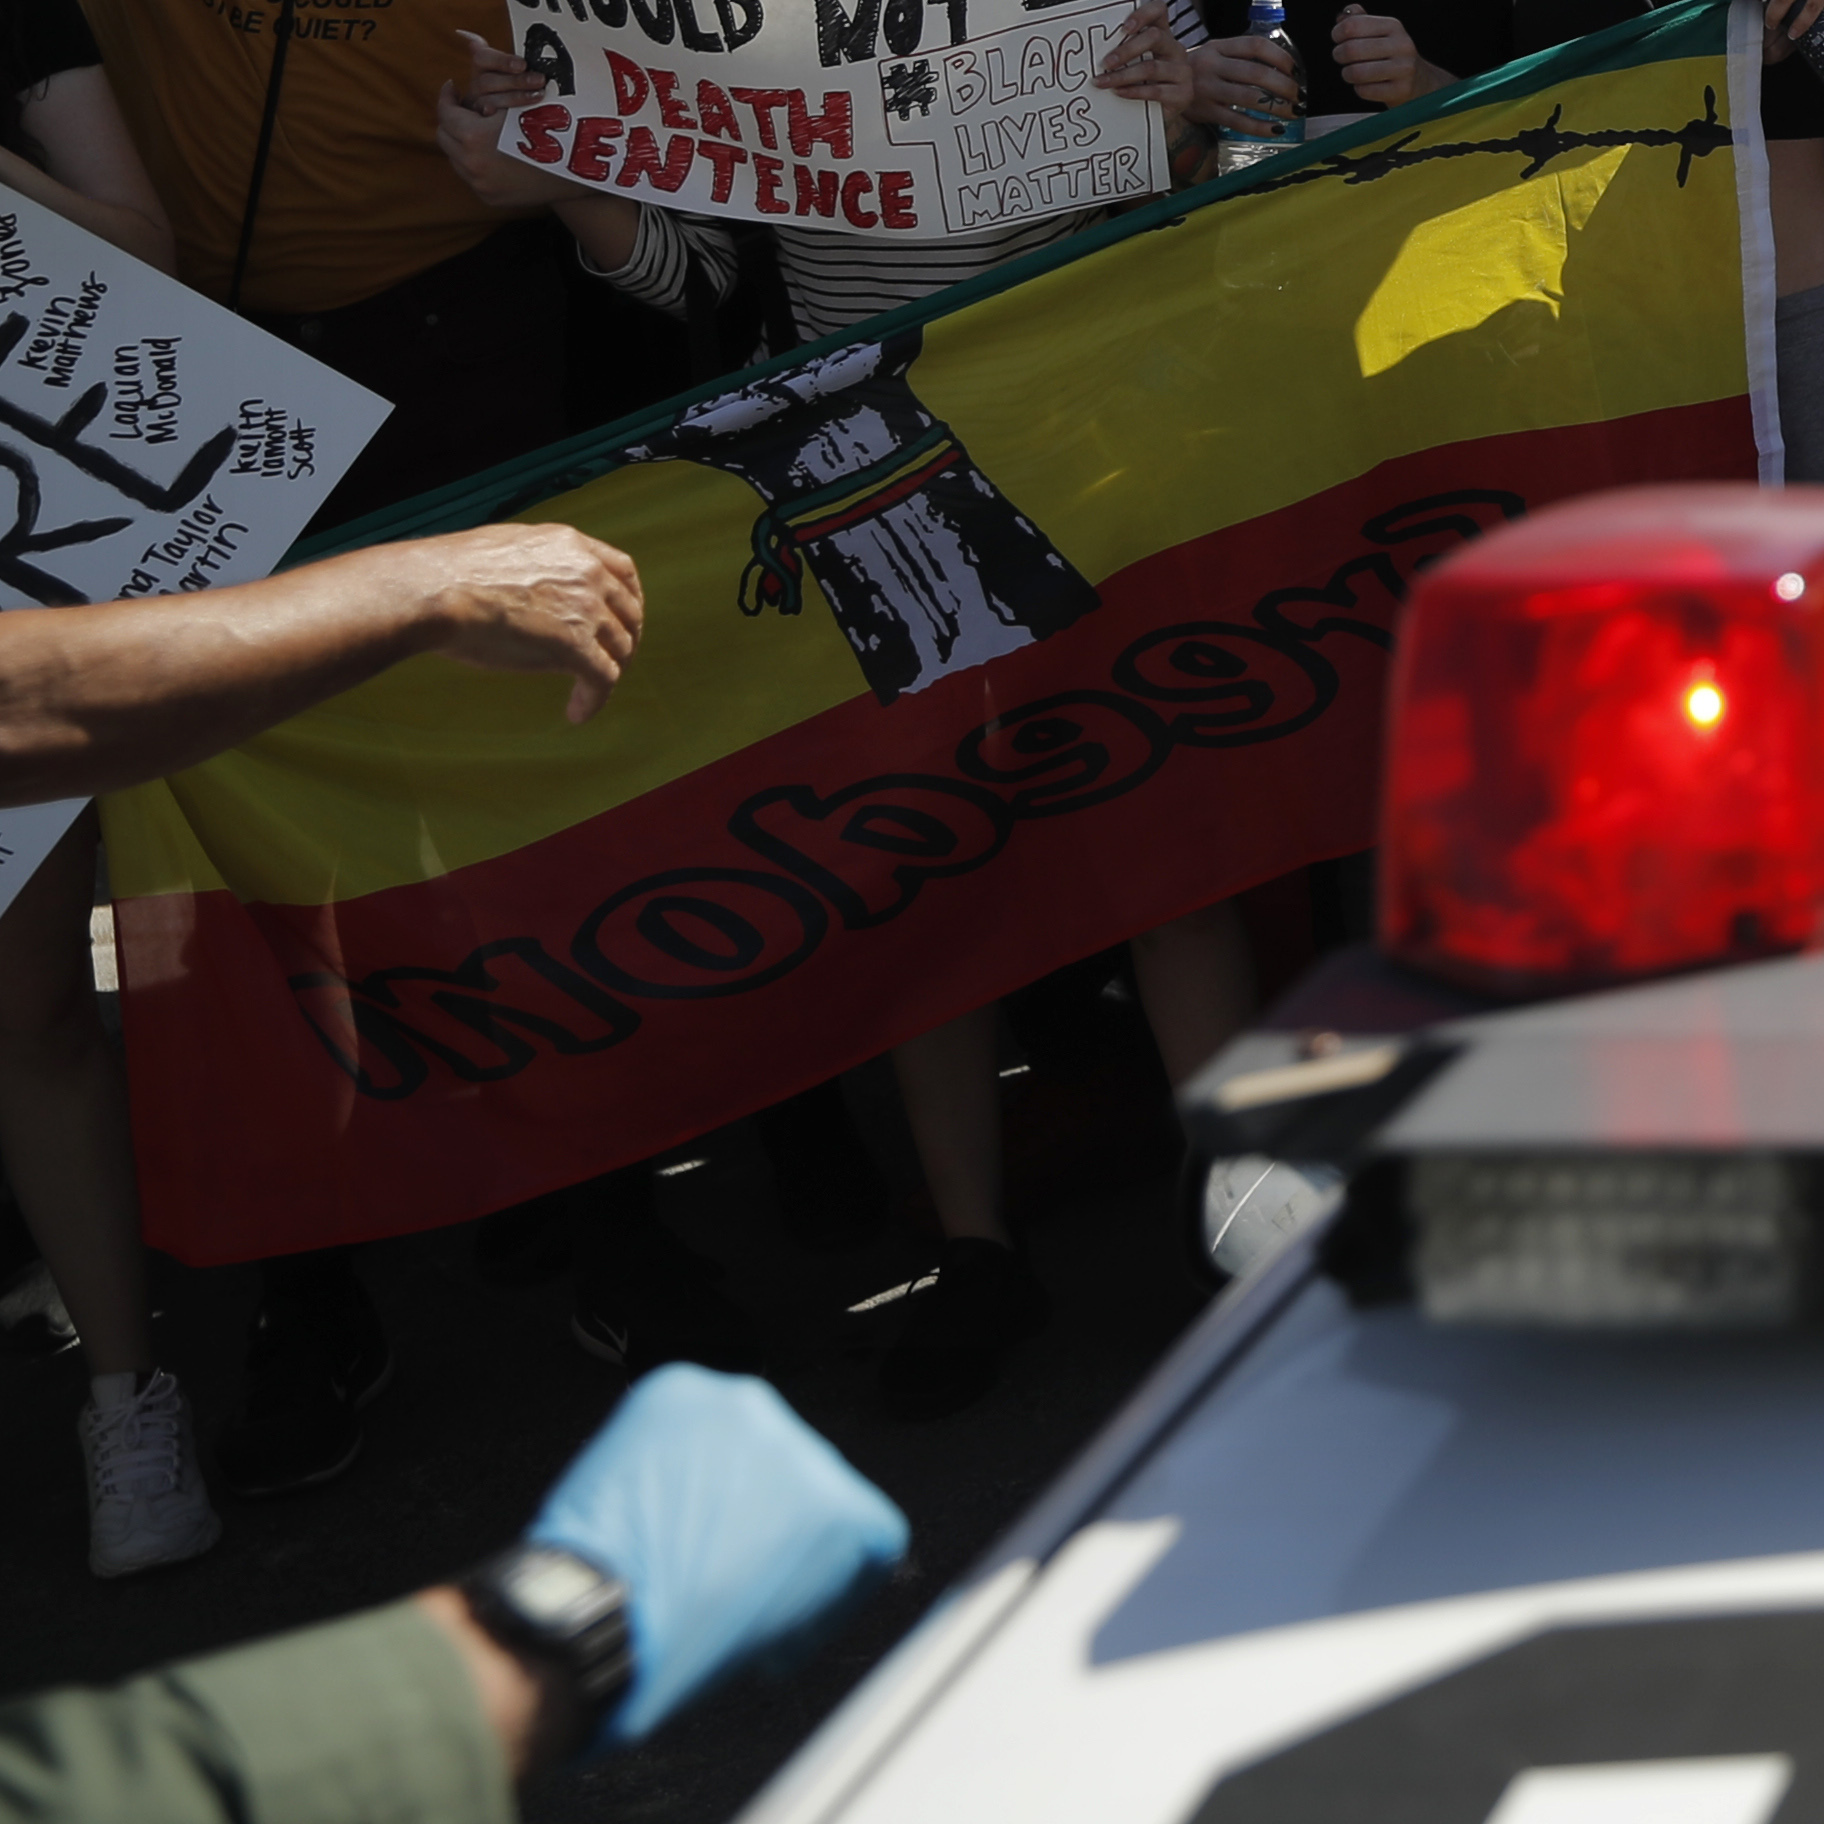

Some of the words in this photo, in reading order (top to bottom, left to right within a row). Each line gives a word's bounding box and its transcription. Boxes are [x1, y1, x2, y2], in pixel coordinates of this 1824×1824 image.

[229, 9, 265, 34] BE
[522, 22, 577, 98] A
[603, 47, 855, 162] DEATH
[515, 103, 919, 232] SENTENCE
[953, 95, 1104, 176] LIVES
[957, 144, 1147, 229] MATTER
[109, 344, 146, 440] Laquan
[140, 336, 183, 445] McDonald
[287, 416, 318, 481] Scott
[140, 492, 226, 568] Taylor
[158, 521, 250, 596] artin
